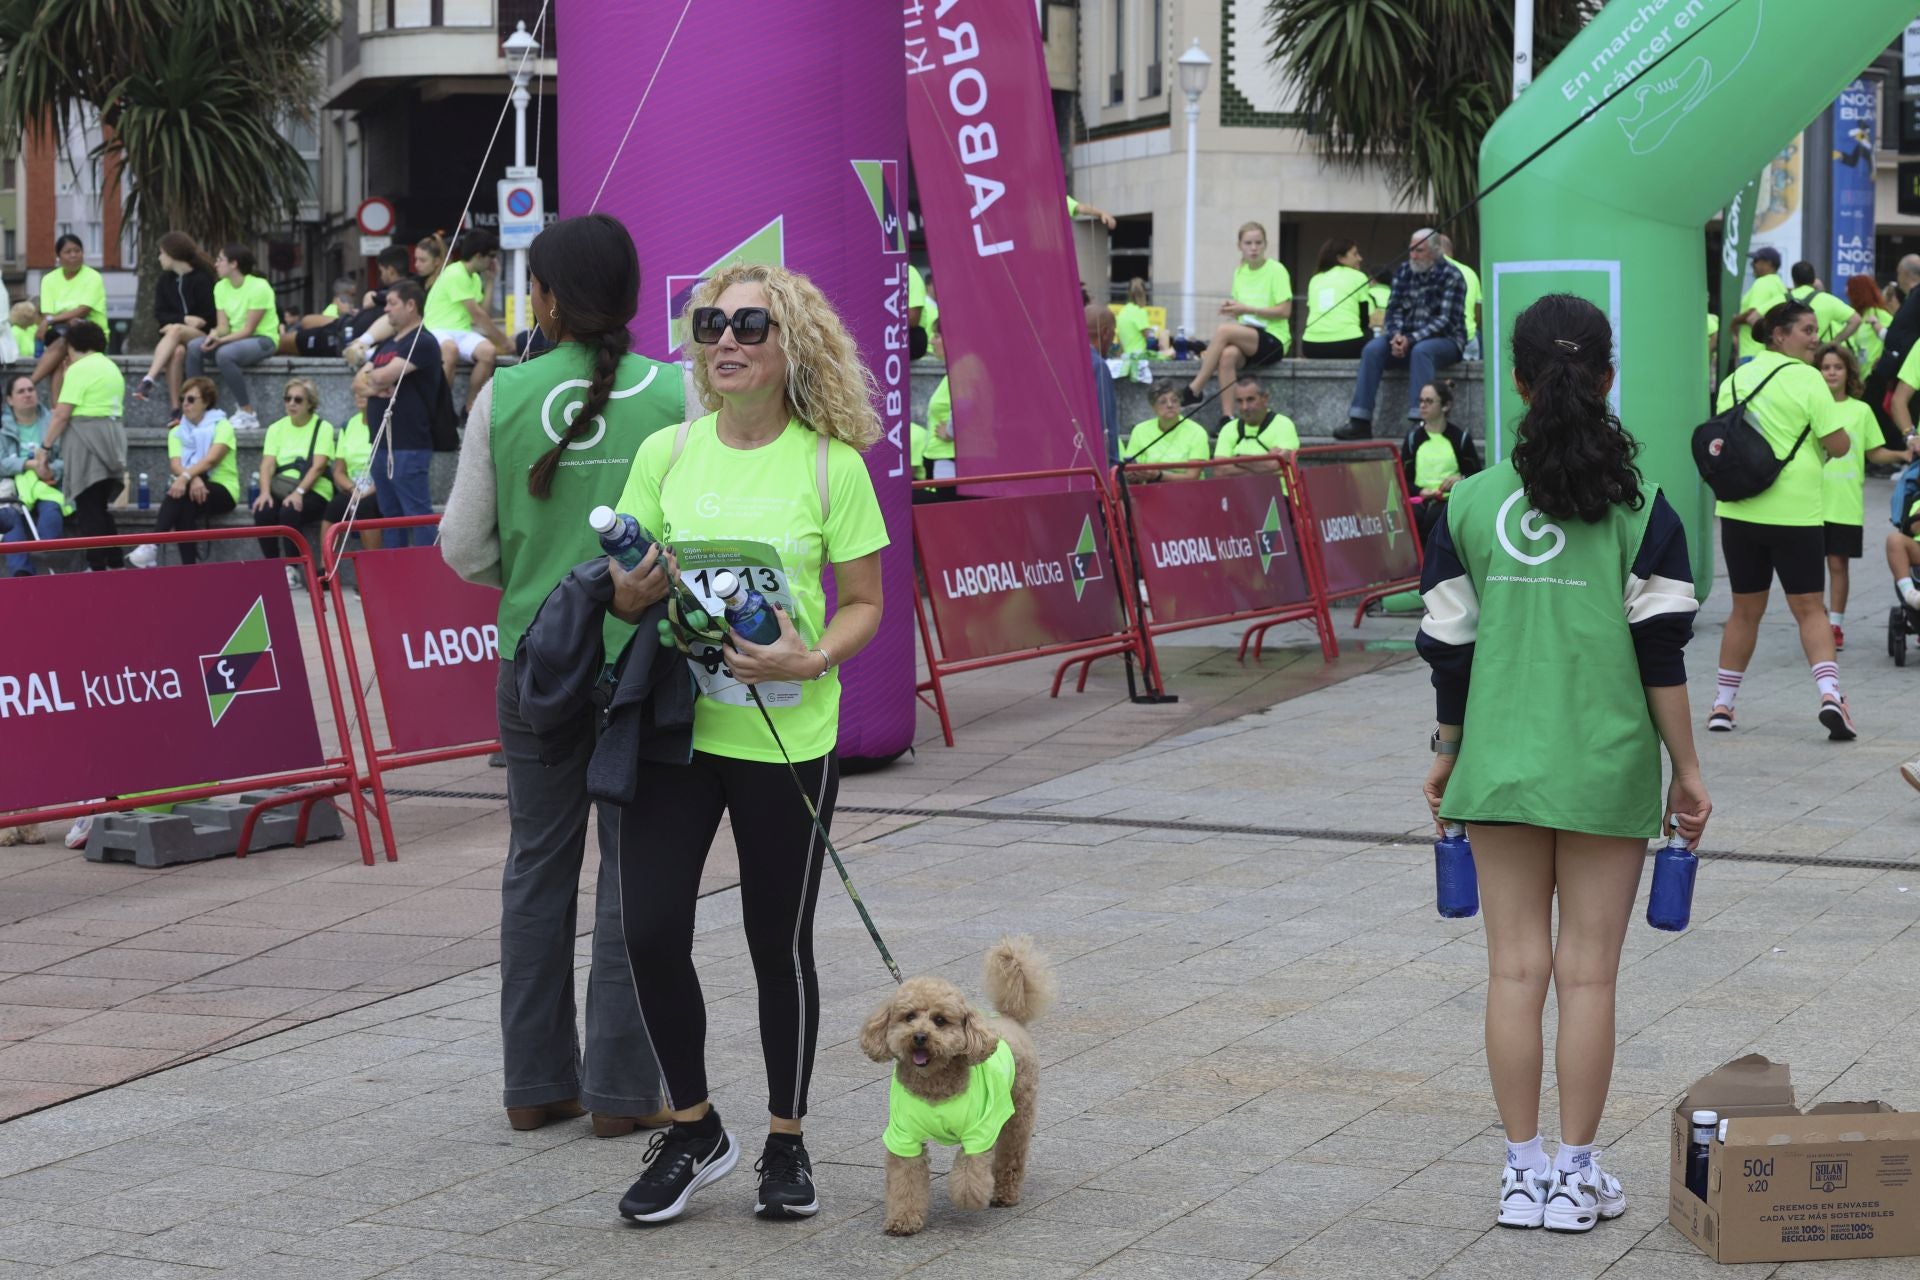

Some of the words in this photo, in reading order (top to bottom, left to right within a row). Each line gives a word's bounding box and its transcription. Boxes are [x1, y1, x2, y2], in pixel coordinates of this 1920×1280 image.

[1560, 68, 1591, 101] En
[1591, 0, 1670, 72] marcha
[1602, 26, 1673, 98] cáncer
[1674, 0, 1706, 29] en
[883, 262, 904, 477] LABORAL
[1321, 515, 1361, 543] LABORAL
[1152, 536, 1216, 568] LABORAL
[1215, 535, 1253, 561] kutxa
[694, 567, 780, 598] 113
[943, 561, 1023, 599] LABORAL
[1021, 559, 1064, 587] kutxa
[402, 624, 499, 669] LABOR
[0, 670, 76, 718] RAL
[81, 666, 182, 708] kutxa
[1743, 1158, 1774, 1177] 50cl
[1747, 1179, 1769, 1192] x20
[1772, 1203, 1819, 1212] CREEMOS
[1821, 1202, 1834, 1210] EN
[1837, 1201, 1880, 1209] ENVASES
[1788, 1213, 1807, 1221] VEZ
[1808, 1211, 1828, 1220] MÁS
[1830, 1210, 1895, 1219] SOSTENIBLES
[1781, 1234, 1825, 1242] RECICLADO
[1801, 1225, 1825, 1234] 100%
[1831, 1232, 1874, 1240] RECICLADO
[1851, 1223, 1874, 1232] 100%
